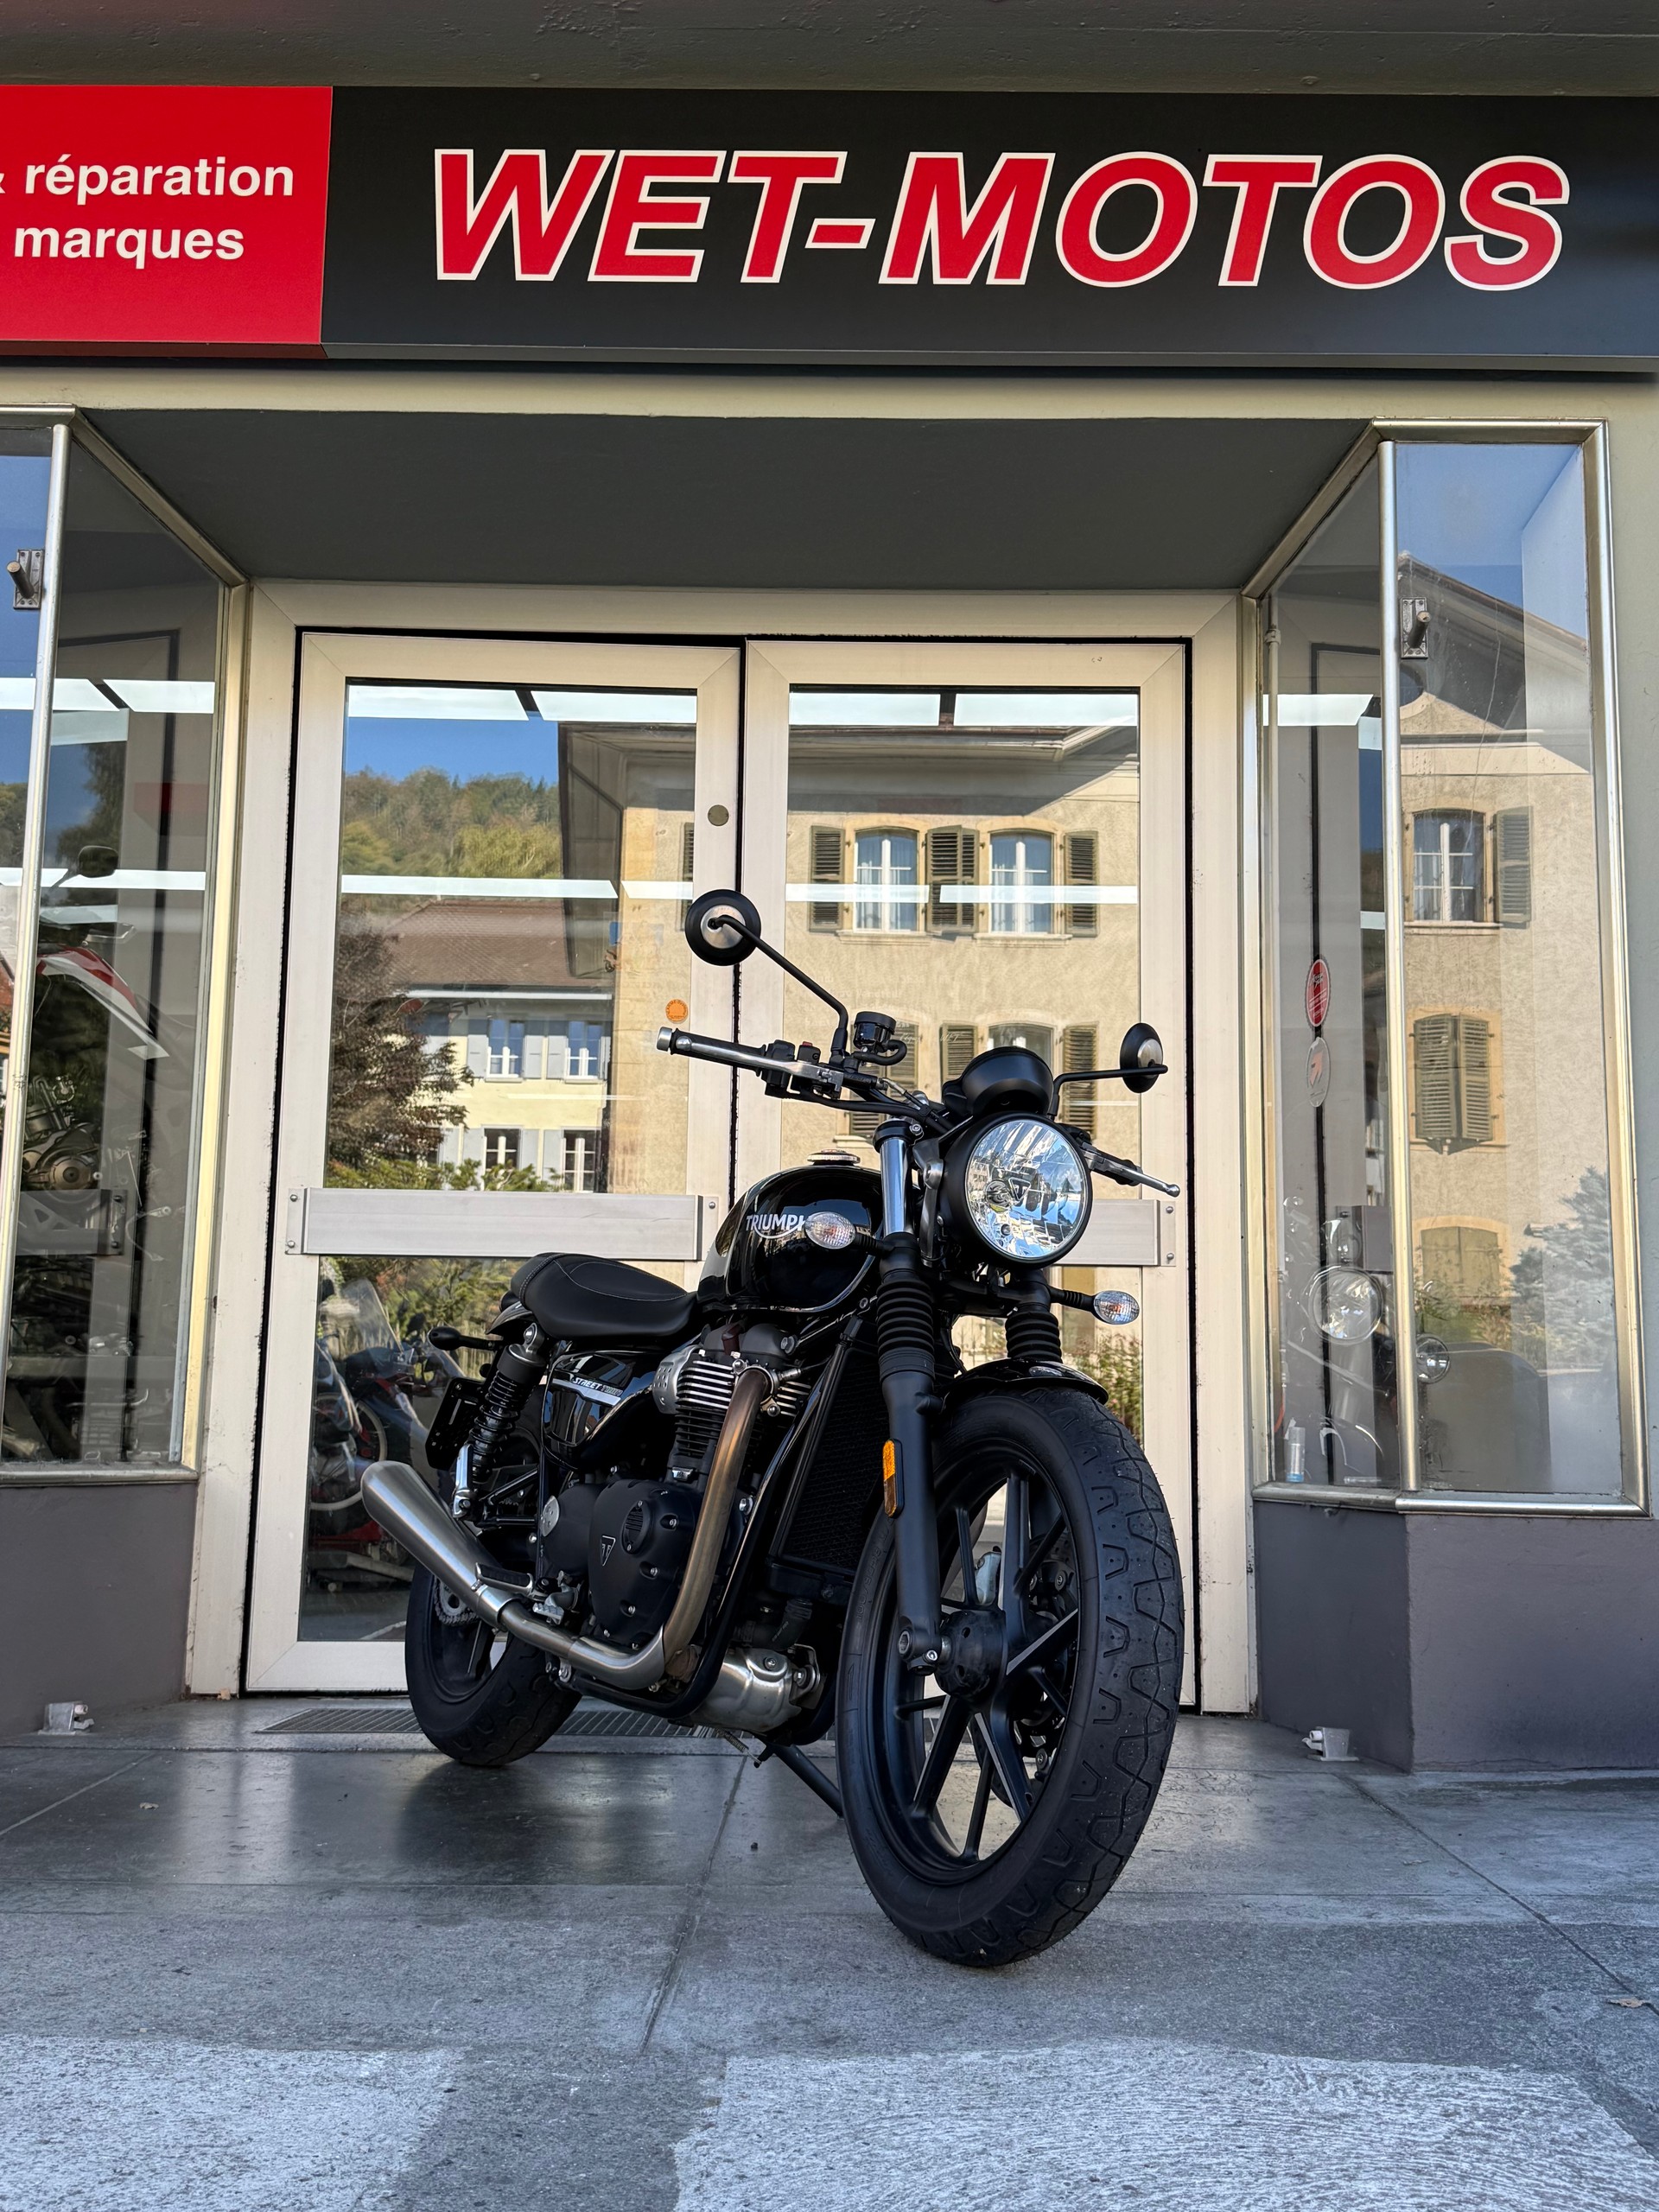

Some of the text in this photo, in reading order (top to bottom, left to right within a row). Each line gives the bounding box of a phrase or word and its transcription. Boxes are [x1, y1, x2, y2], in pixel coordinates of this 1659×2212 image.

[25, 153, 294, 206] réparation
[435, 149, 1570, 291] WET-MOTOS
[14, 226, 245, 270] marques
[573, 1377, 601, 1389] STREET
